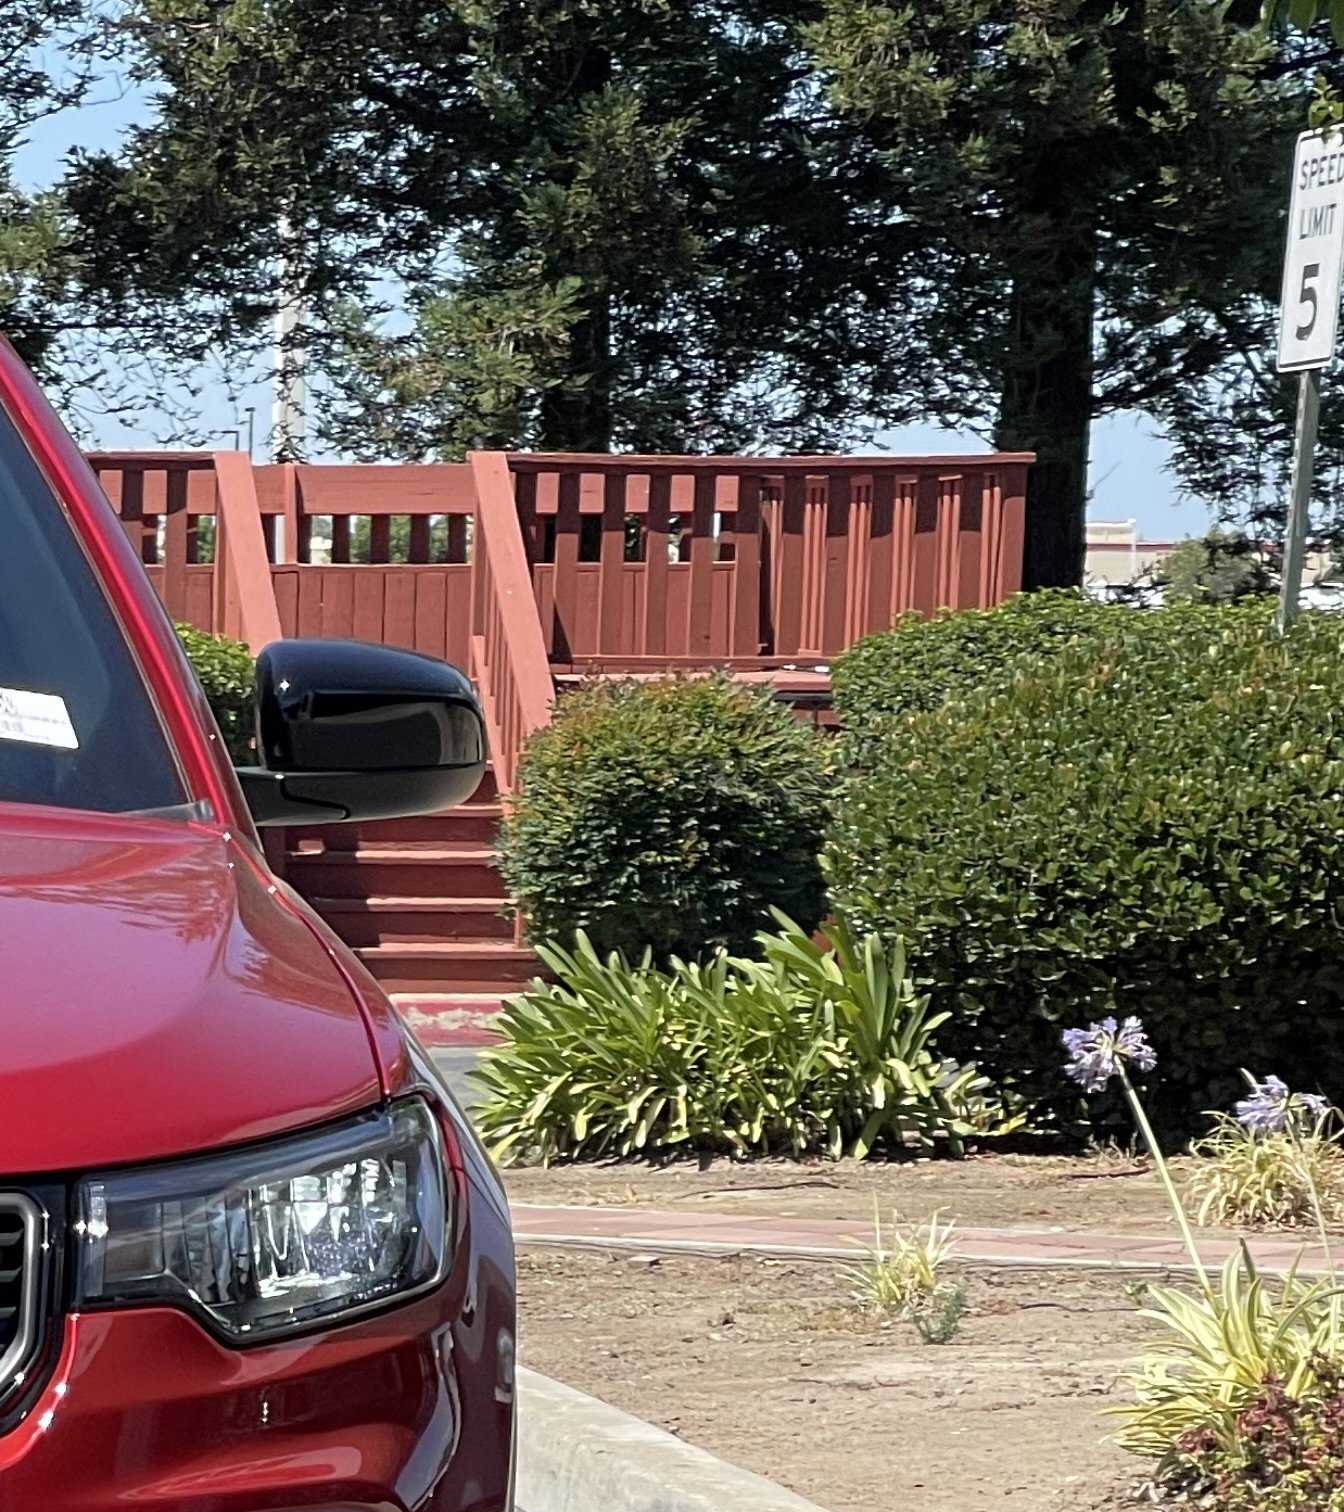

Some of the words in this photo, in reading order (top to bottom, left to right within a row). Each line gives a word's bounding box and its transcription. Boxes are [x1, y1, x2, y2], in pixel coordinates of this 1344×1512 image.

[1300, 153, 1344, 190] SPEED
[1299, 203, 1337, 240] LIMIT
[1295, 263, 1320, 341] 5
